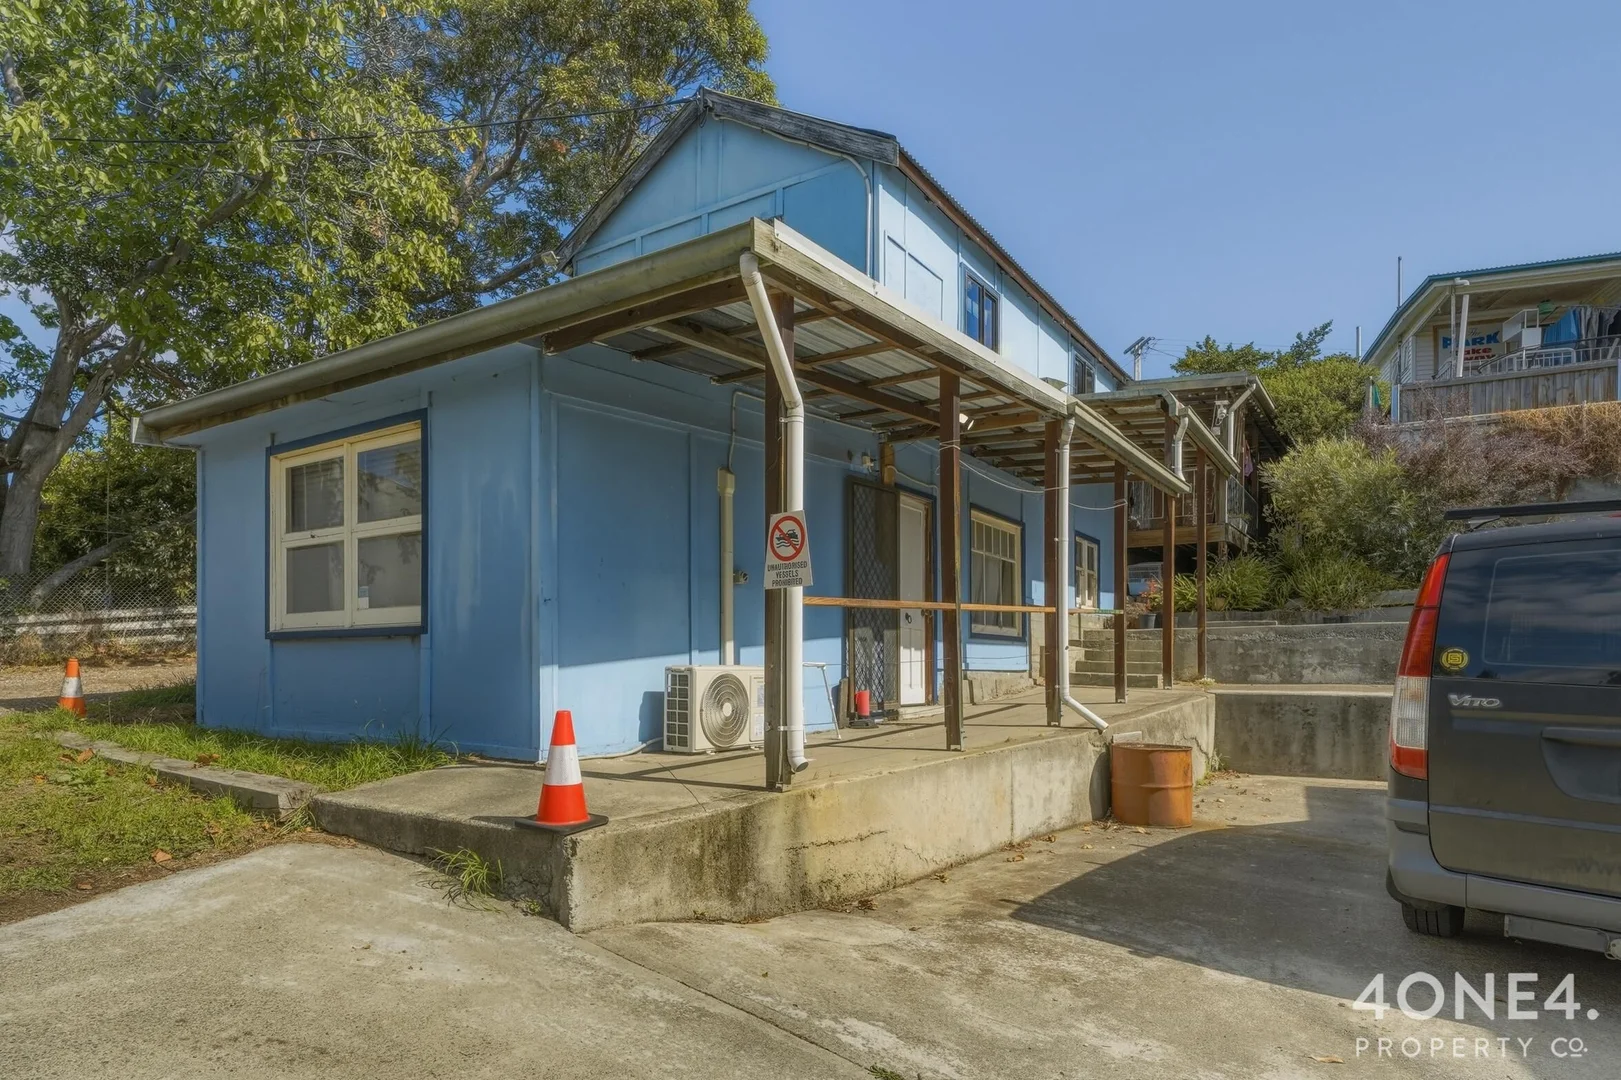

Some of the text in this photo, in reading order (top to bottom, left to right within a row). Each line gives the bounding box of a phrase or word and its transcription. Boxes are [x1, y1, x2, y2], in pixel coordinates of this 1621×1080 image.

[767, 561, 808, 572] UNAUTHORISED
[776, 570, 799, 579] VESSELS
[772, 578, 803, 587] PROHIBITED
